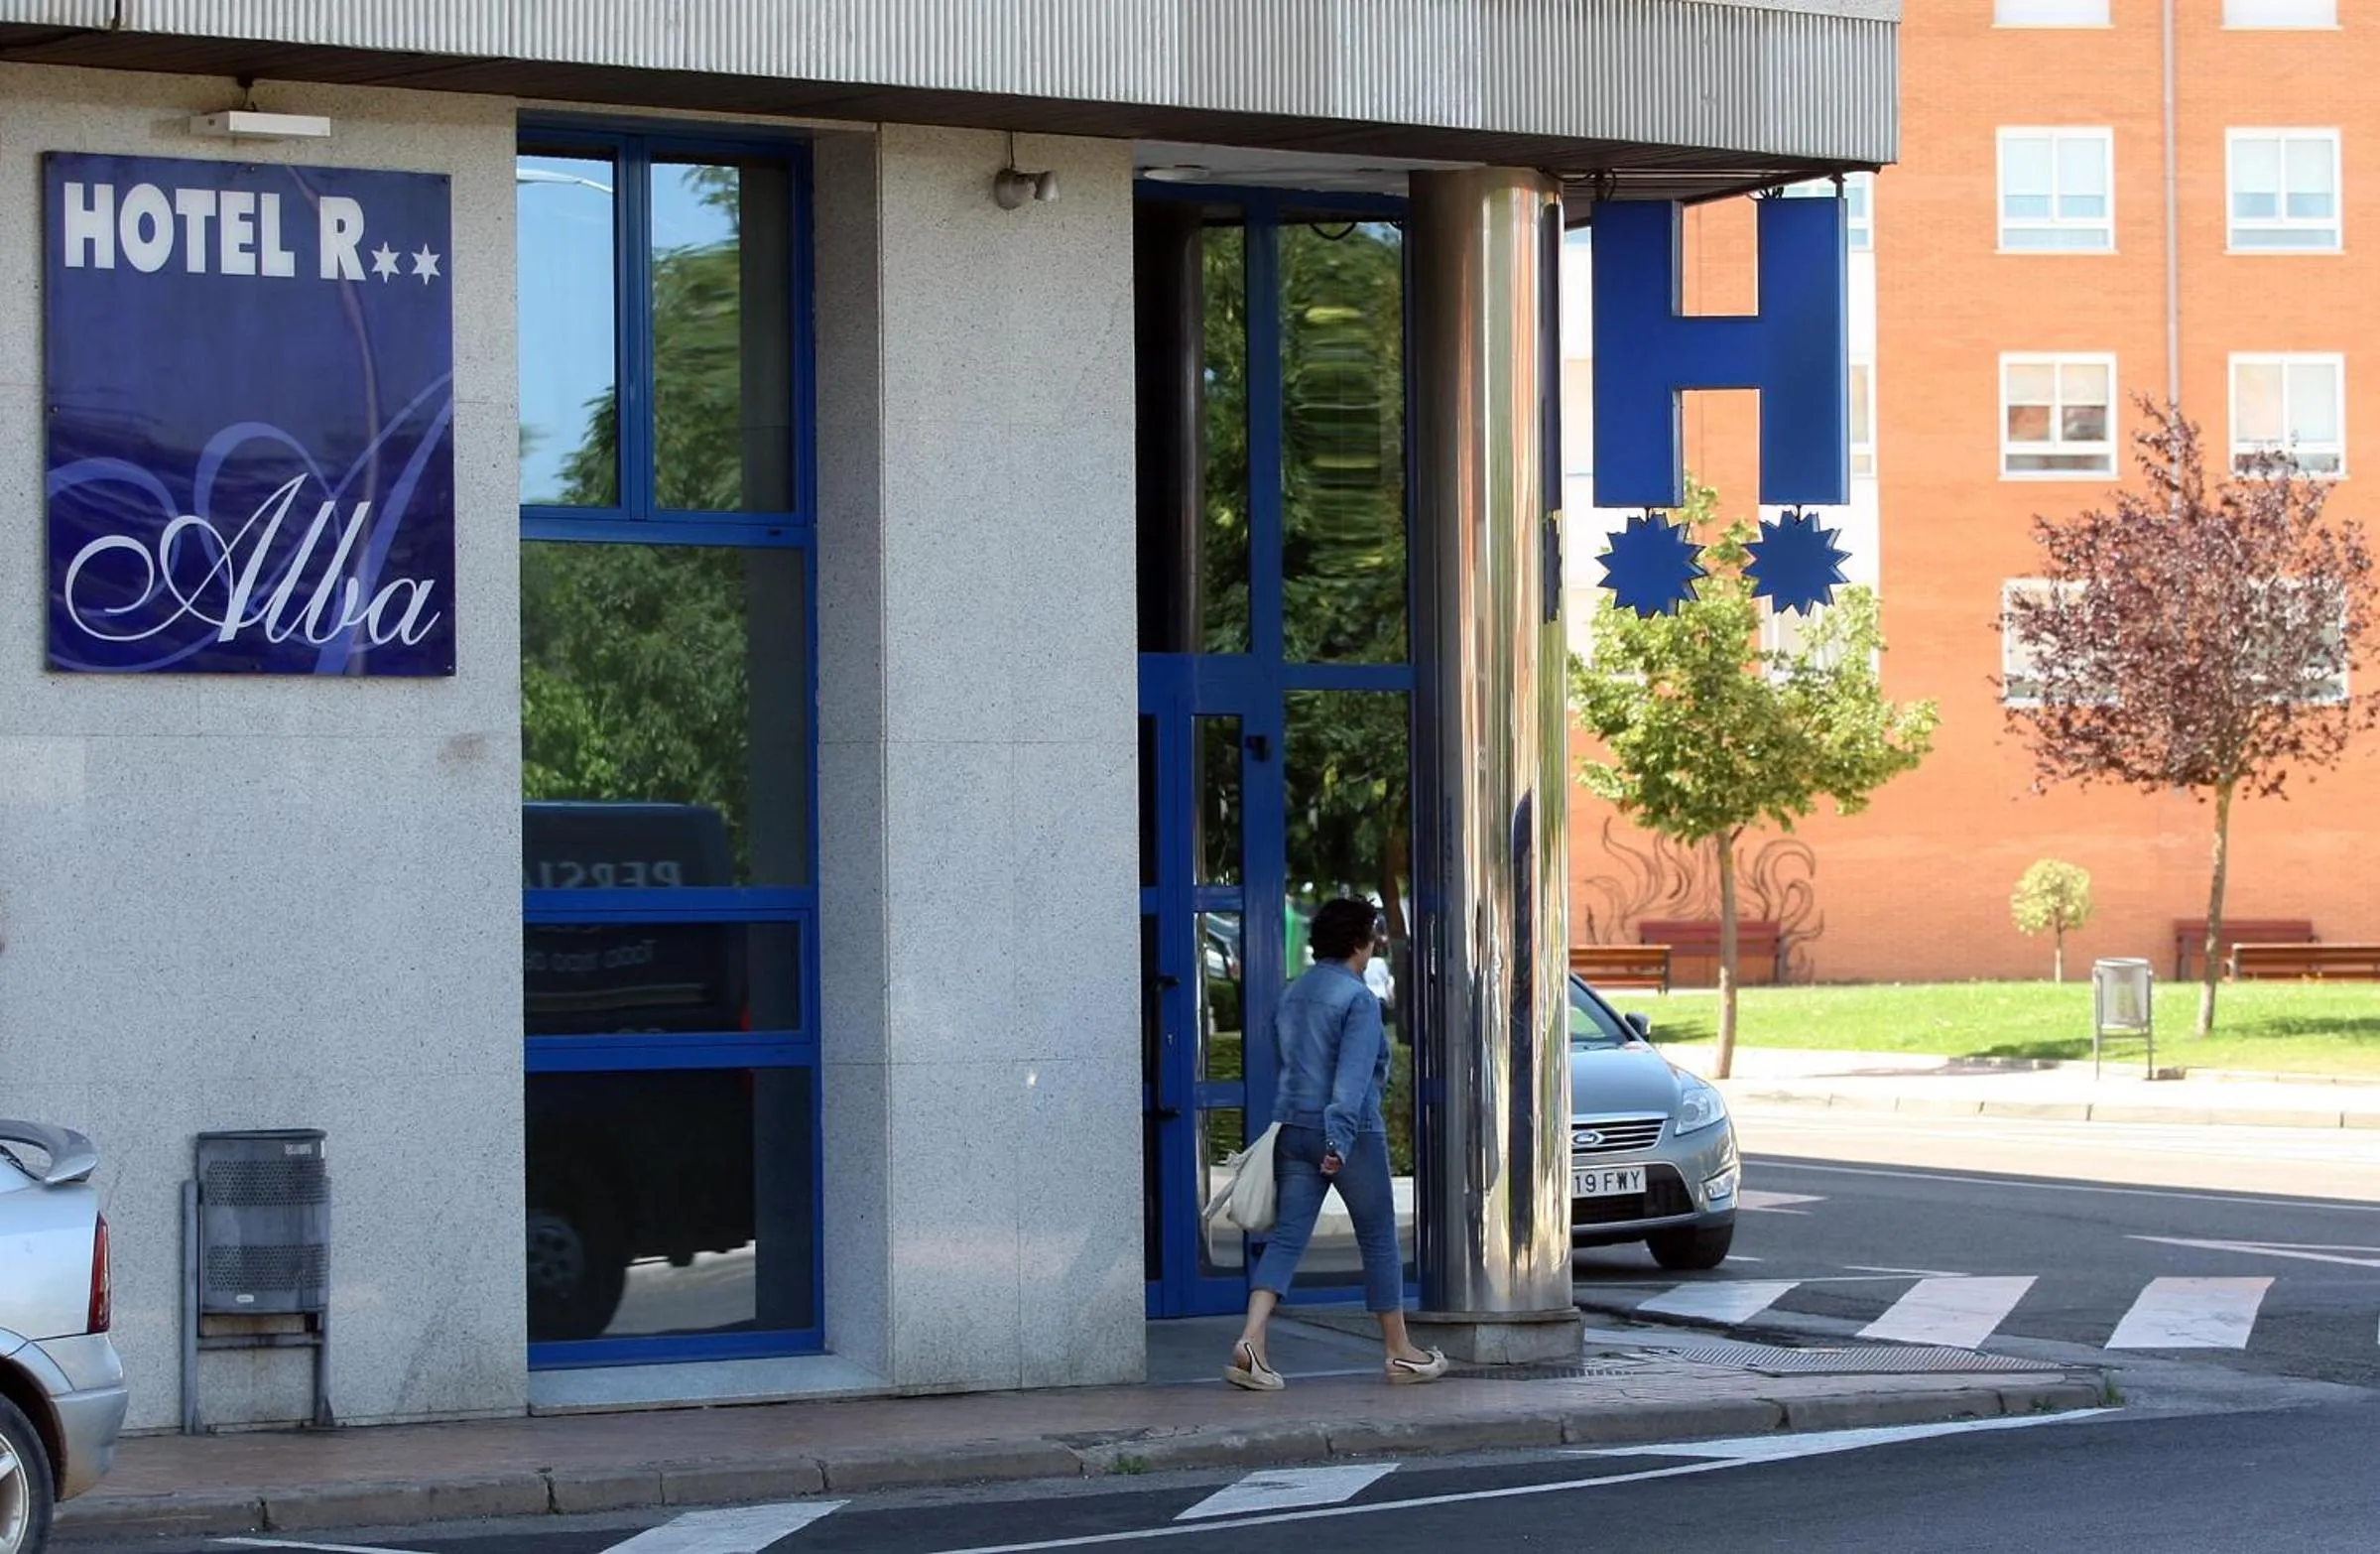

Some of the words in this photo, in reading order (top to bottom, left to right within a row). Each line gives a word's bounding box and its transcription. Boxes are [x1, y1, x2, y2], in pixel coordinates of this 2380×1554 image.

[64, 183, 295, 277] HOTEL
[319, 196, 366, 281] R
[1591, 197, 1850, 507] H
[65, 472, 440, 646] Alba
[1603, 1171, 1642, 1191] FWY
